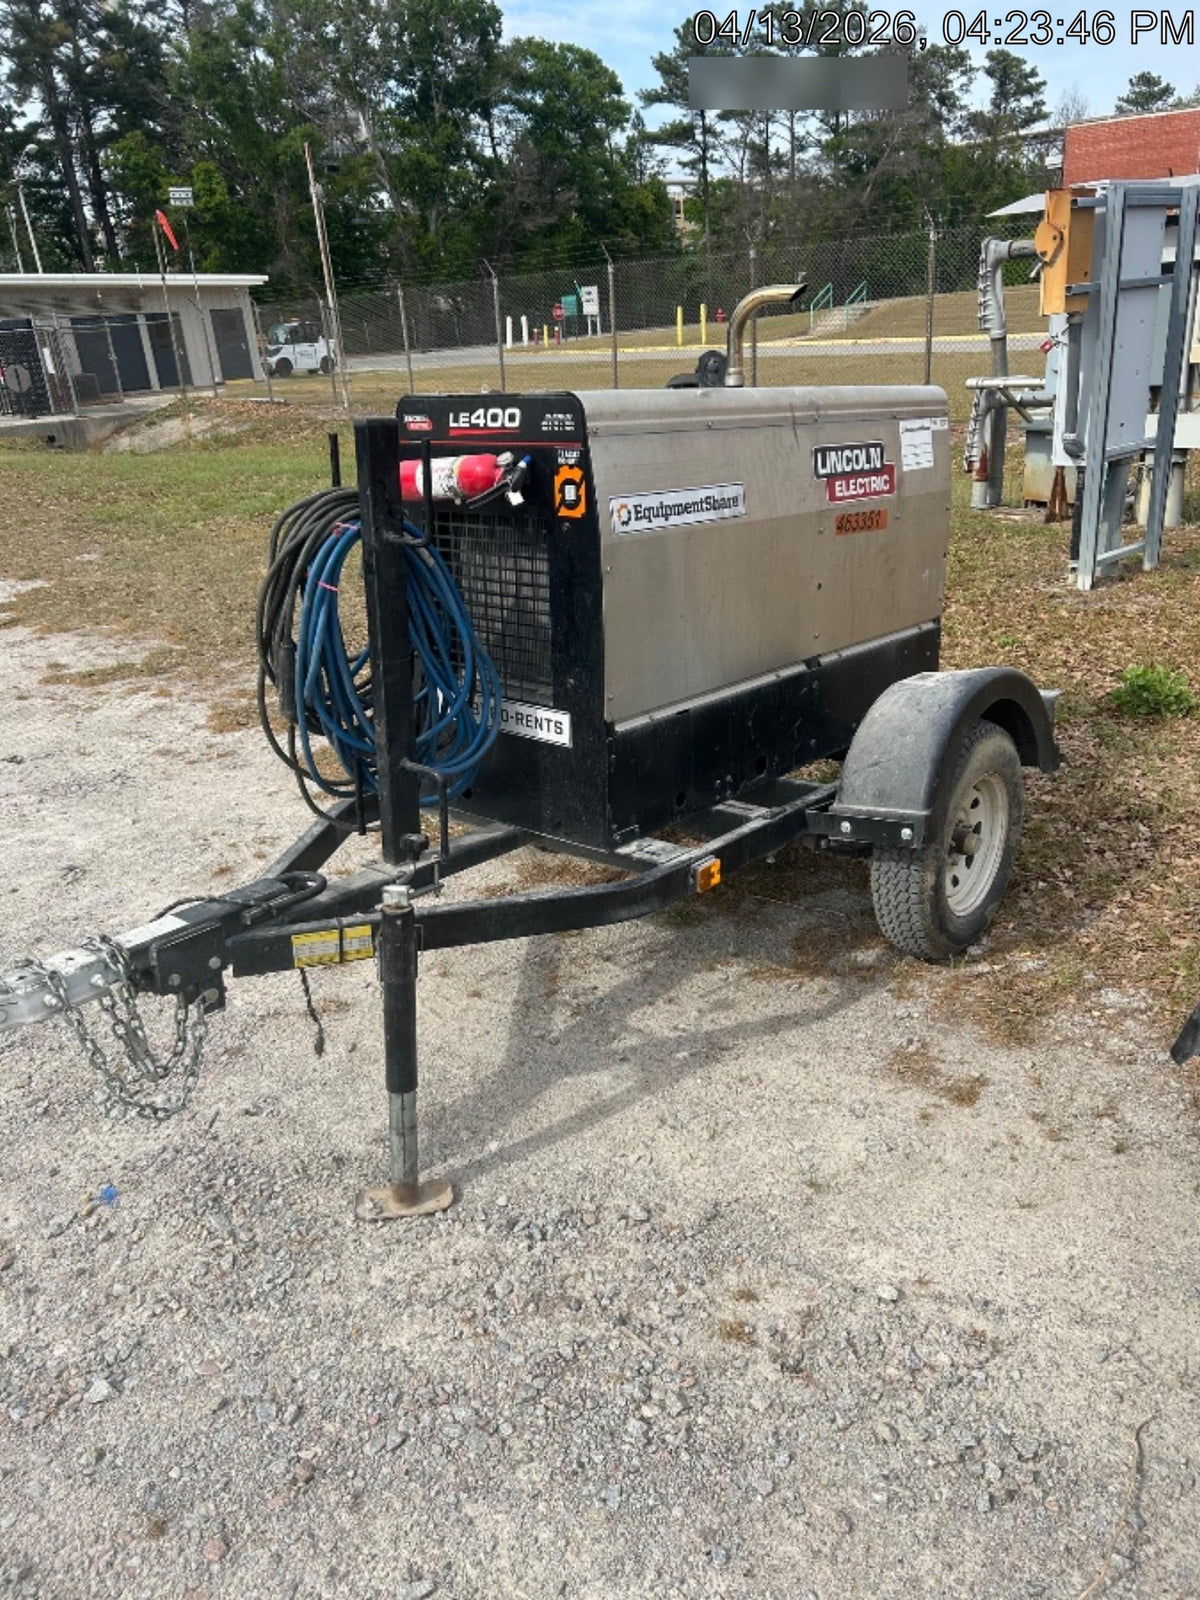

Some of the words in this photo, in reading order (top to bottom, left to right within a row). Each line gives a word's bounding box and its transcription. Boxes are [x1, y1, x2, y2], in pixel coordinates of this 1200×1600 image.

[449, 407, 521, 428] LE400
[817, 447, 881, 475] LINCOLN
[834, 474, 890, 497] ELECTRIC
[632, 495, 739, 523] EquipmentShare
